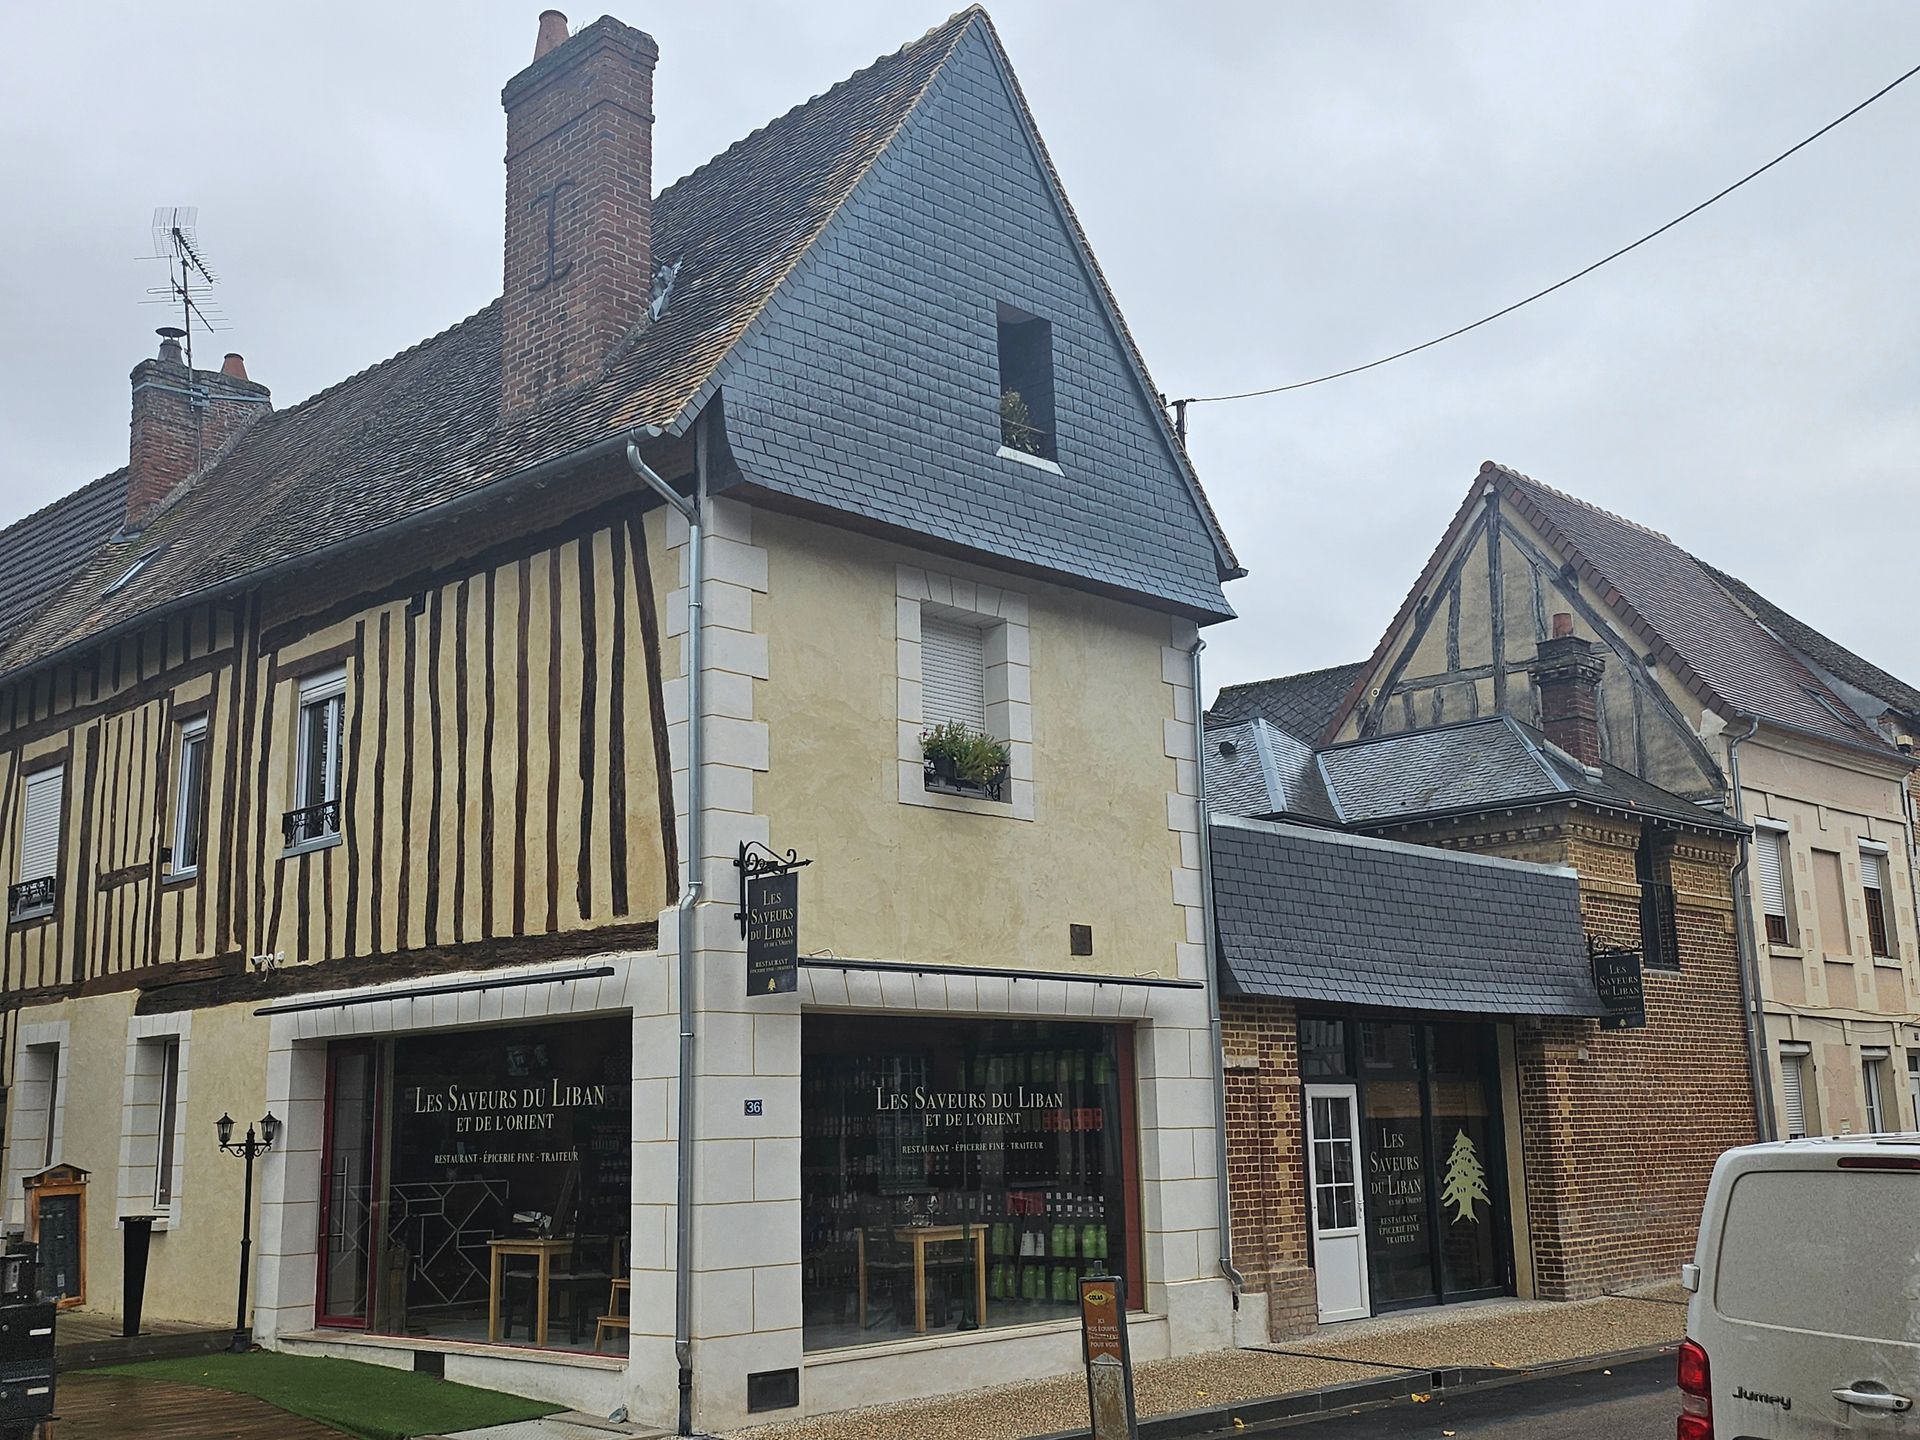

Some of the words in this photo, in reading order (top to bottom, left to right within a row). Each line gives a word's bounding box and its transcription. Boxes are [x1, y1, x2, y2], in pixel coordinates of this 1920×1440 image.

[763, 890, 782, 906] LES
[751, 908, 794, 925] SAVEURS
[750, 930, 762, 941] DU
[764, 924, 794, 940] LIBAN
[1609, 964, 1627, 975] LES
[1600, 975, 1638, 986] SAVEURS
[1613, 985, 1640, 996] LIBAN
[415, 1086, 443, 1113] LES
[448, 1084, 518, 1112] SAVEURS
[523, 1088, 546, 1109] DU
[552, 1078, 606, 1107] LIBAN
[876, 1086, 909, 1110] LES
[914, 1086, 986, 1110] SAVEURS
[992, 1092, 1012, 1108] DU
[1018, 1086, 1064, 1108] LIBAN
[746, 1101, 761, 1113] 36
[456, 1117, 472, 1133] ET
[475, 1115, 492, 1132] DE
[496, 1113, 554, 1131] L'ORIENT
[925, 1114, 941, 1127] ET
[945, 1113, 963, 1126] DE
[966, 1112, 1022, 1126] L'ORIENT
[1383, 1127, 1405, 1149] LES
[902, 1144, 950, 1154] RESTAURANT
[955, 1141, 988, 1152] ÉPICERIE
[988, 1142, 1006, 1151] FINE
[1011, 1141, 1044, 1150] TRAITEUR
[434, 1153, 478, 1164] RESTAURANT
[483, 1150, 515, 1163] ÉPICERIE
[517, 1152, 535, 1162] FINE
[541, 1151, 579, 1162] TRAITEUR
[1370, 1151, 1419, 1173] SAVEURS
[1371, 1182, 1384, 1195] DU
[1388, 1175, 1421, 1196] LIBAN
[1381, 1214, 1417, 1225] RESTAURANT
[1386, 1234, 1415, 1244] TRAITEUR
[1732, 1386, 1792, 1410] Jumpy
